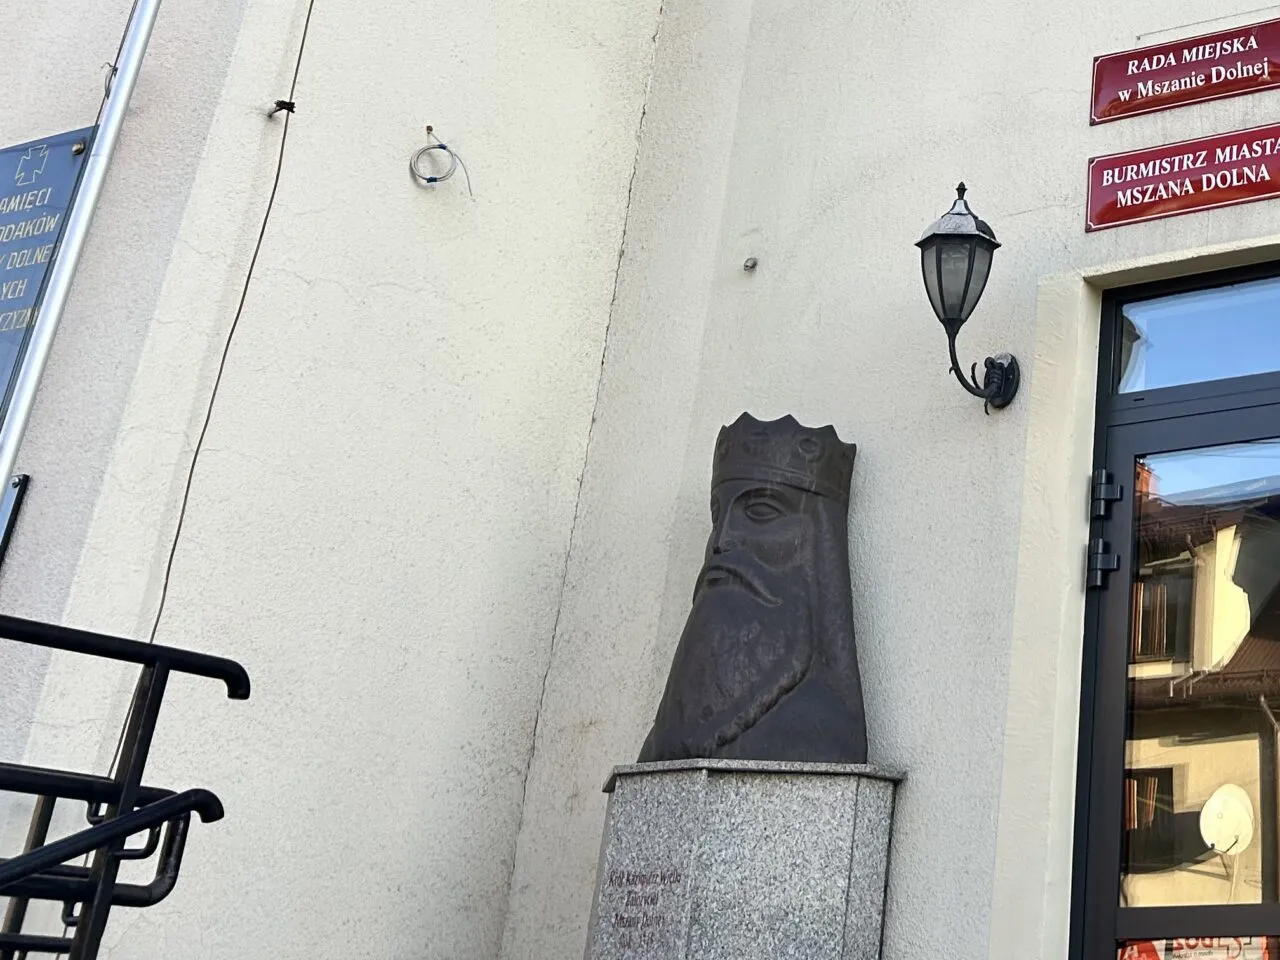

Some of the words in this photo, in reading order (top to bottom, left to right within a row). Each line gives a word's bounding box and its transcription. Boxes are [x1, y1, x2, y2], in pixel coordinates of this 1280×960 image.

[1126, 50, 1176, 76] RADA
[1181, 34, 1258, 63] MIEJSKA
[1117, 87, 1132, 102] w
[1137, 69, 1206, 99] Mszanie
[1211, 57, 1269, 82] Dolnej
[1102, 150, 1207, 186] BURMISTRZ
[1116, 177, 1194, 208] MSZANA
[1202, 163, 1271, 191] DOLNA
